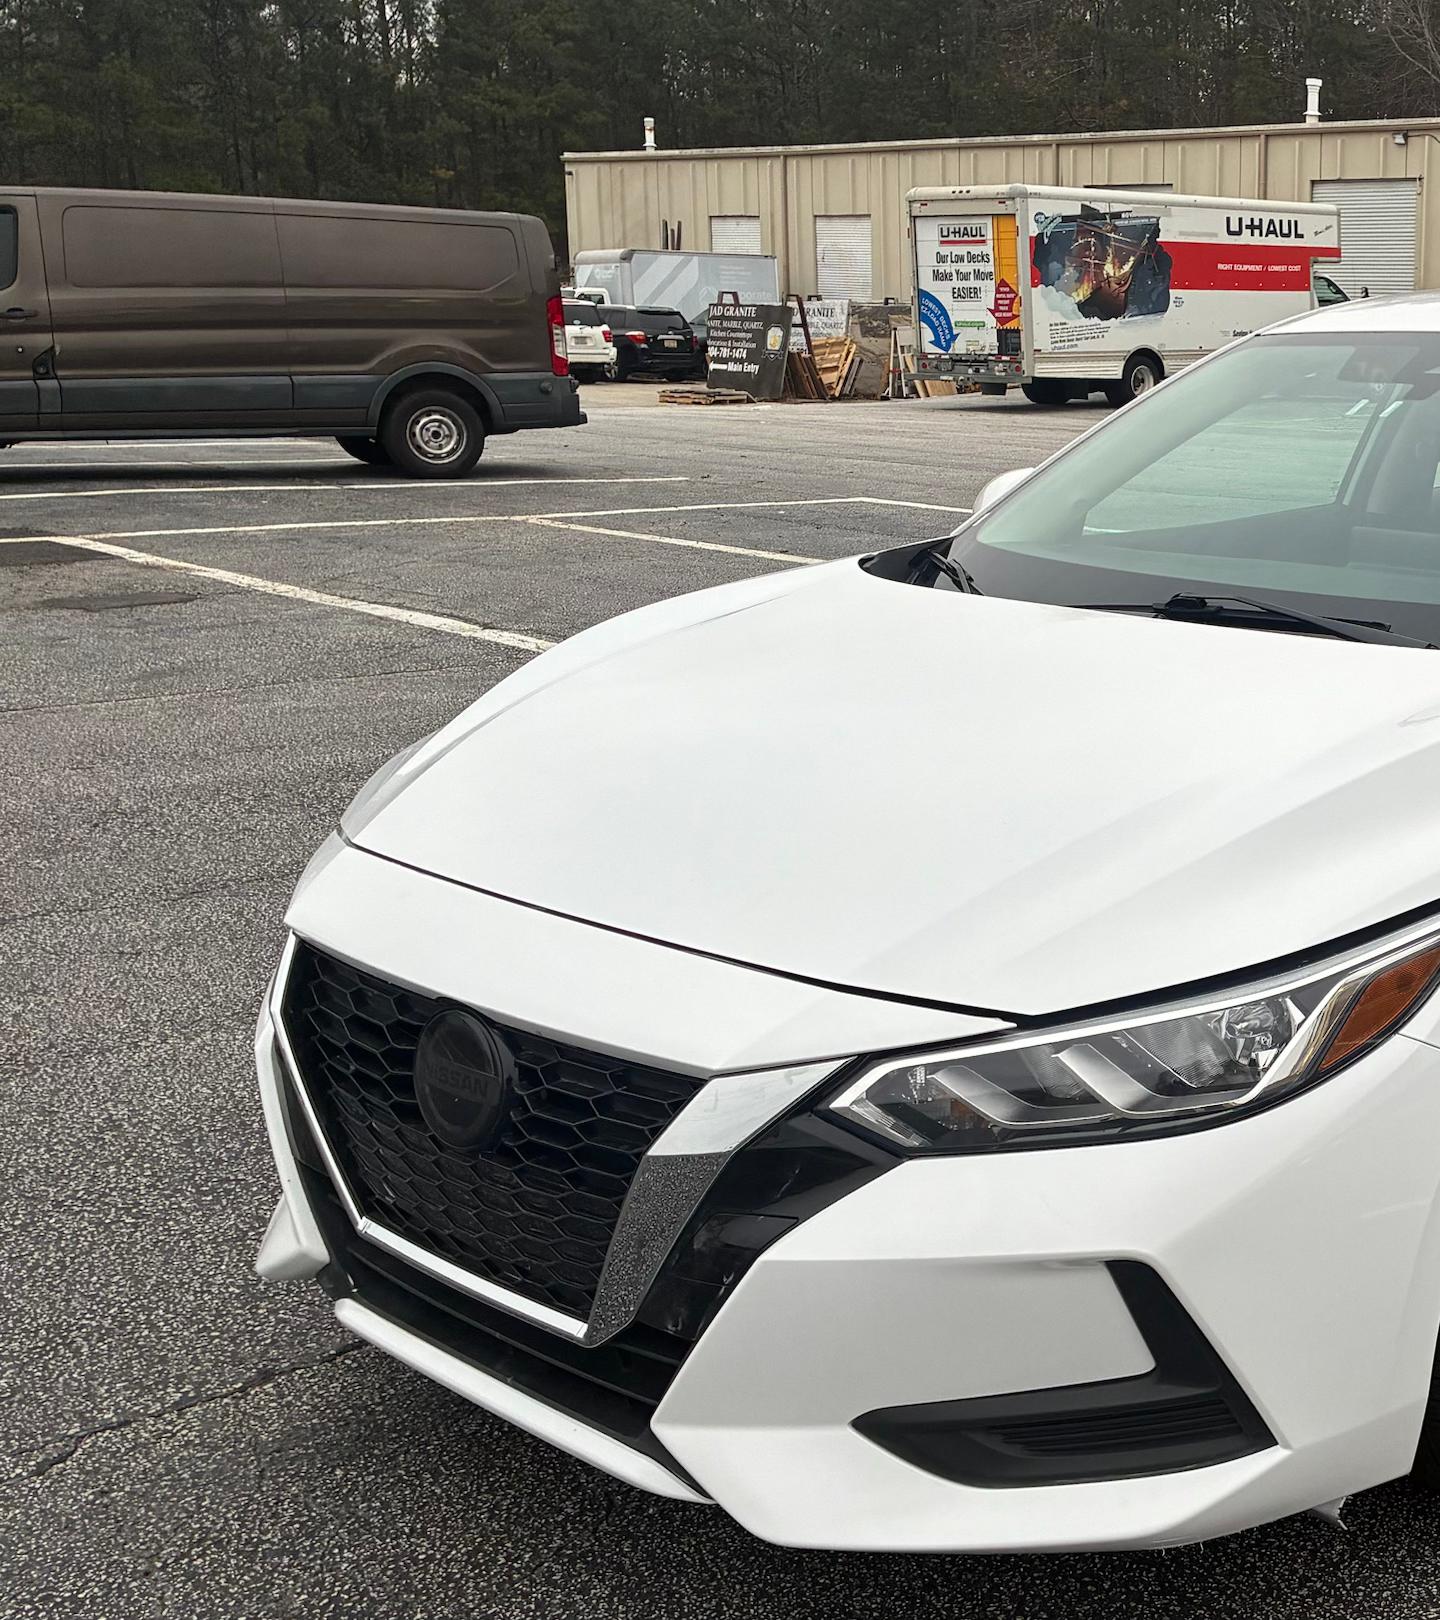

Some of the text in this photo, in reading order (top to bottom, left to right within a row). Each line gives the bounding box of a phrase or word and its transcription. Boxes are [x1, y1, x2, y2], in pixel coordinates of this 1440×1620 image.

[940, 226, 986, 238] U-HAUL
[1225, 216, 1305, 239] U-HAUL
[936, 251, 990, 264] Our Low Decks
[1233, 263, 1263, 272] EQUIPMENT
[1267, 264, 1288, 272] LOWEST
[1288, 264, 1302, 272] COST
[932, 268, 994, 282] Make Your Move
[952, 286, 982, 300] EASIER!
[709, 305, 757, 318] JAD GRANITE
[806, 307, 836, 318] RANITE
[742, 320, 764, 330] QUARTZ
[727, 361, 760, 375] Main Entry
[422, 1061, 489, 1098] NISSAN
